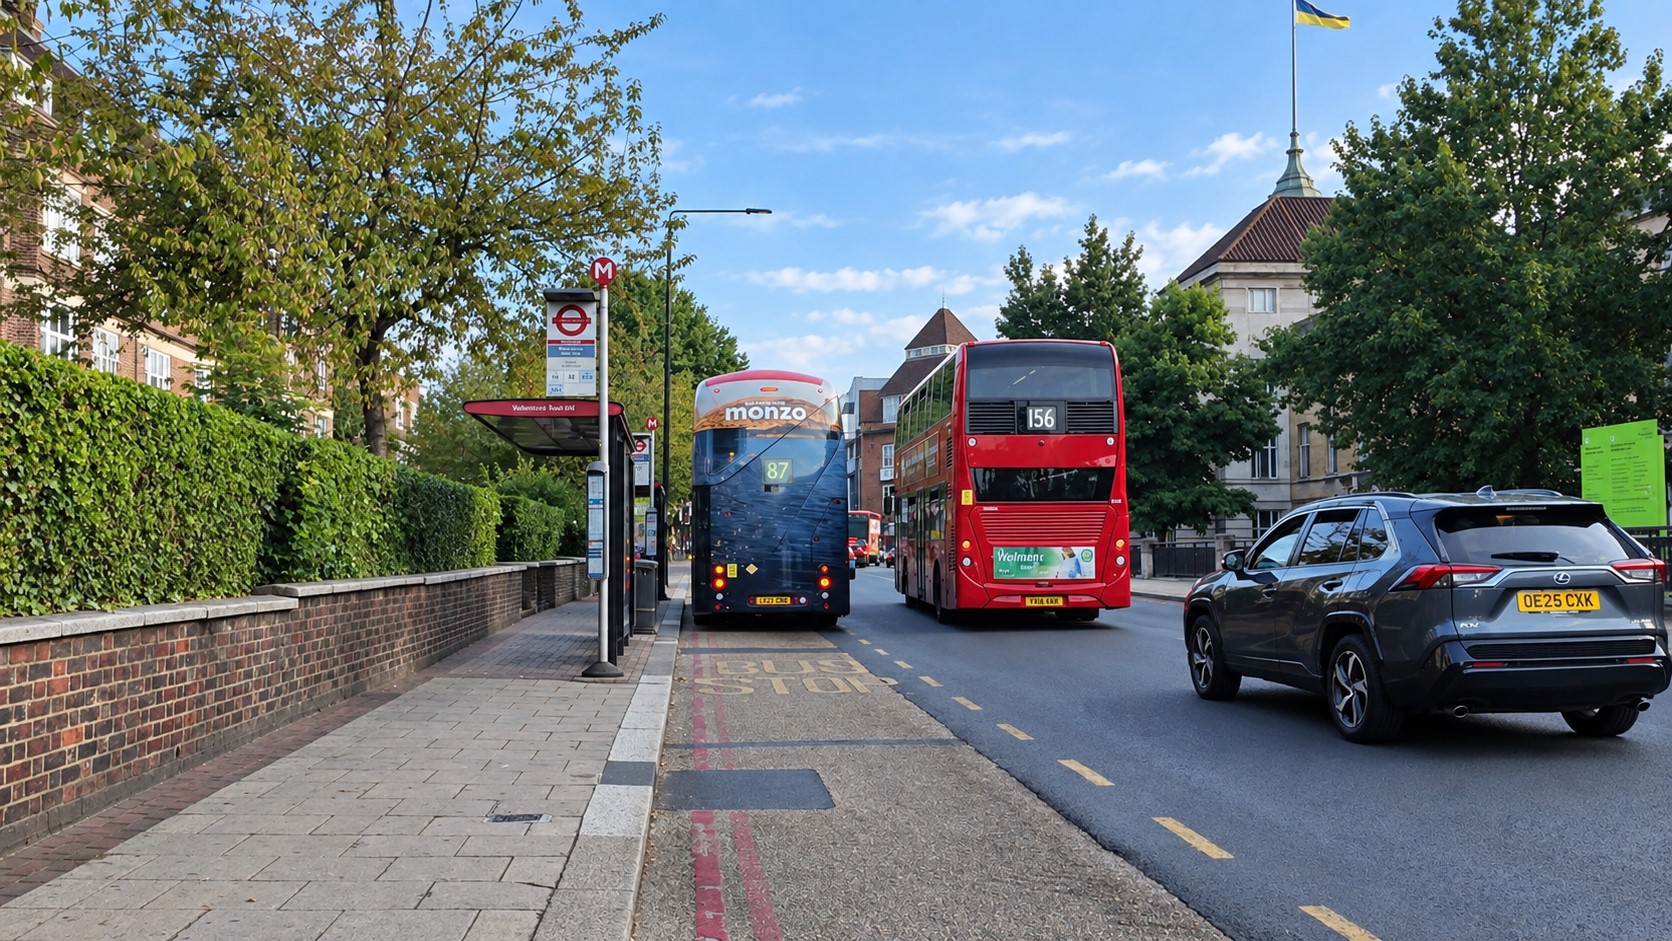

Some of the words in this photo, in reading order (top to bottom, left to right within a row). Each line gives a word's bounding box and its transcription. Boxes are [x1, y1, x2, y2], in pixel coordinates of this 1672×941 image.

[595, 262, 612, 279] M
[725, 406, 807, 421] monzo
[1028, 409, 1055, 428] 156
[648, 418, 657, 428] M
[766, 461, 789, 479] 87
[1523, 593, 1562, 608] OE25
[1565, 593, 1593, 607] CXK
[716, 659, 869, 675] BUS
[694, 676, 898, 695] STOP
